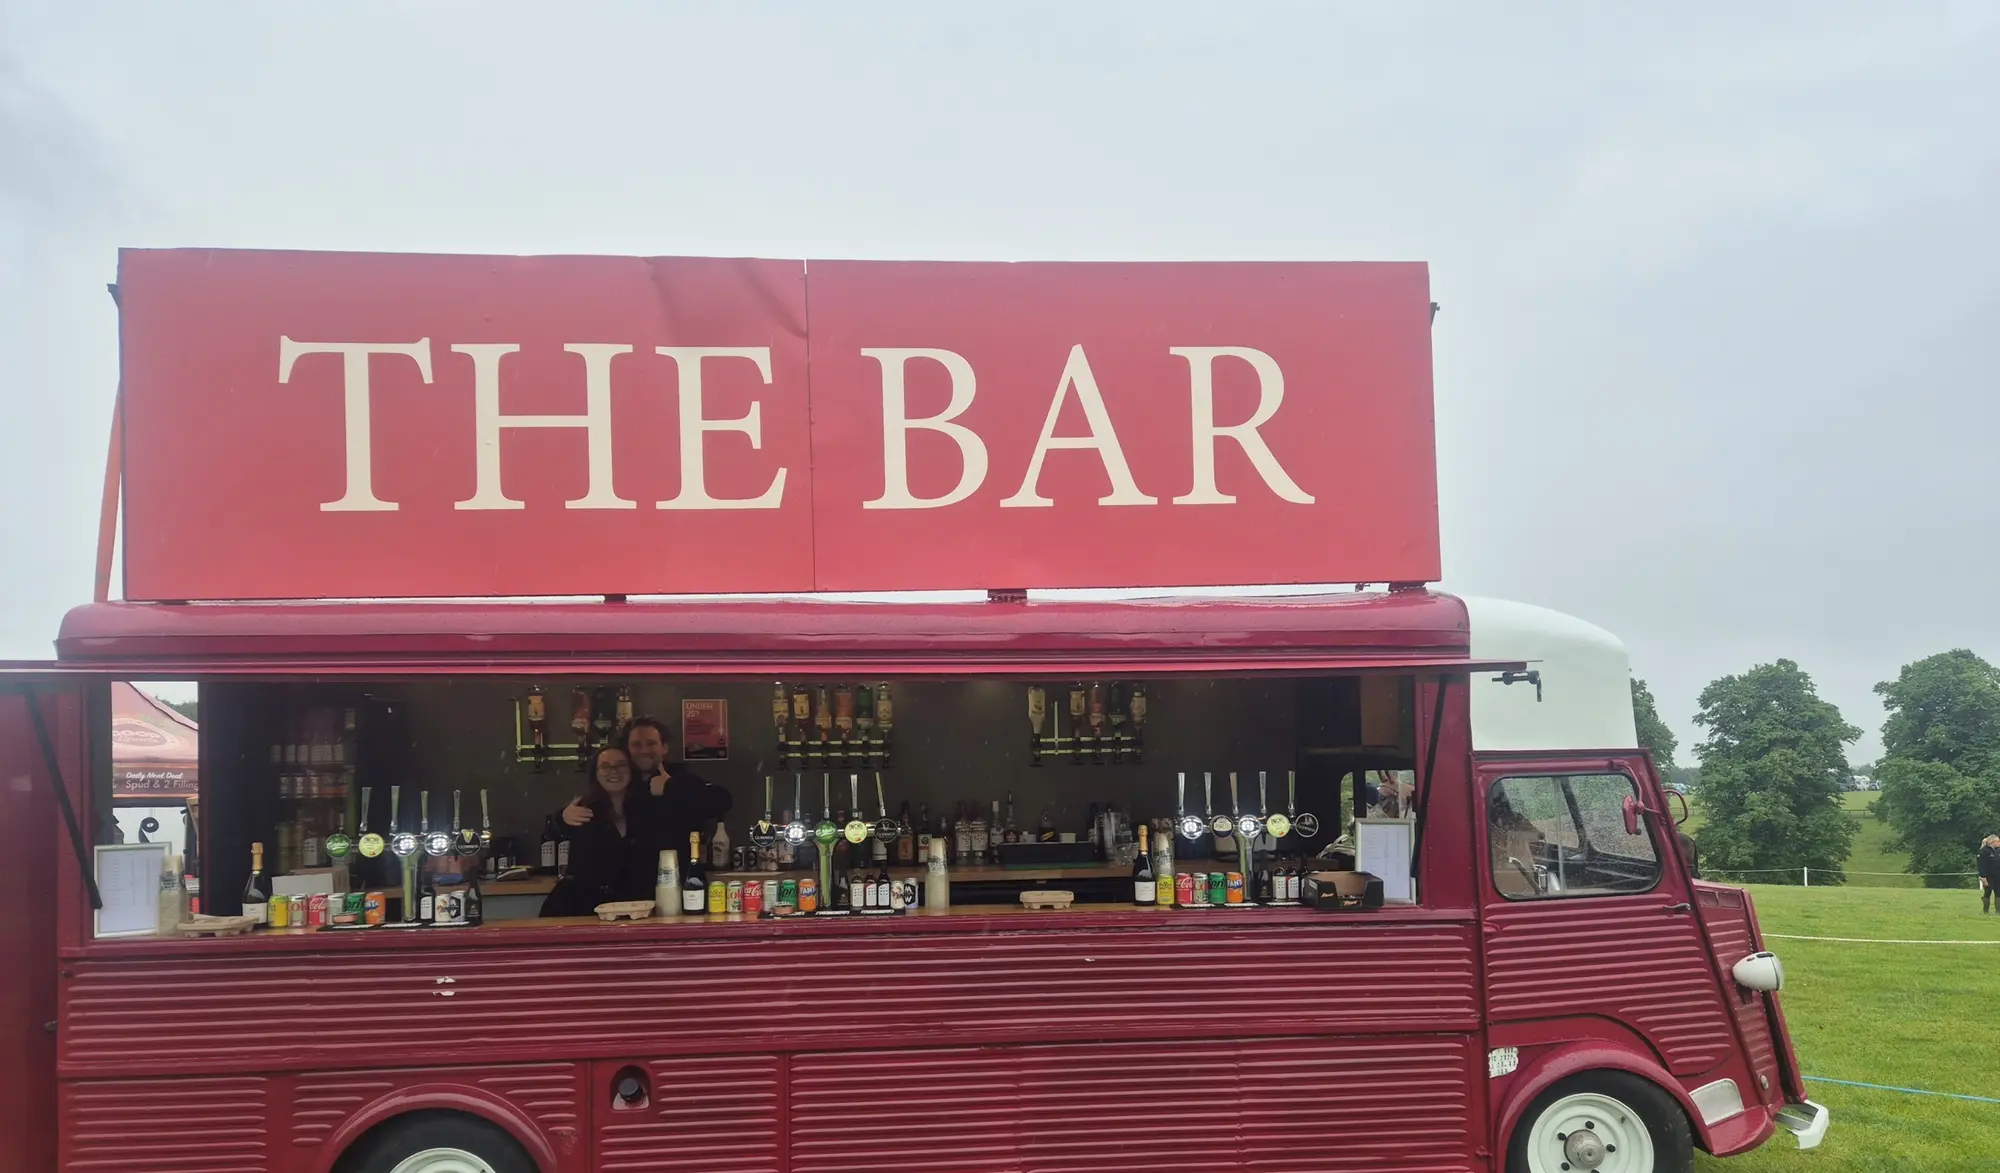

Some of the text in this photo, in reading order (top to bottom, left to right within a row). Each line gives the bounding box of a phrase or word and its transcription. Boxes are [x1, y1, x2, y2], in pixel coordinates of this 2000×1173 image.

[278, 335, 1316, 511] THE BAR
[125, 772, 145, 781] Daily
[125, 780, 150, 790] Spud
